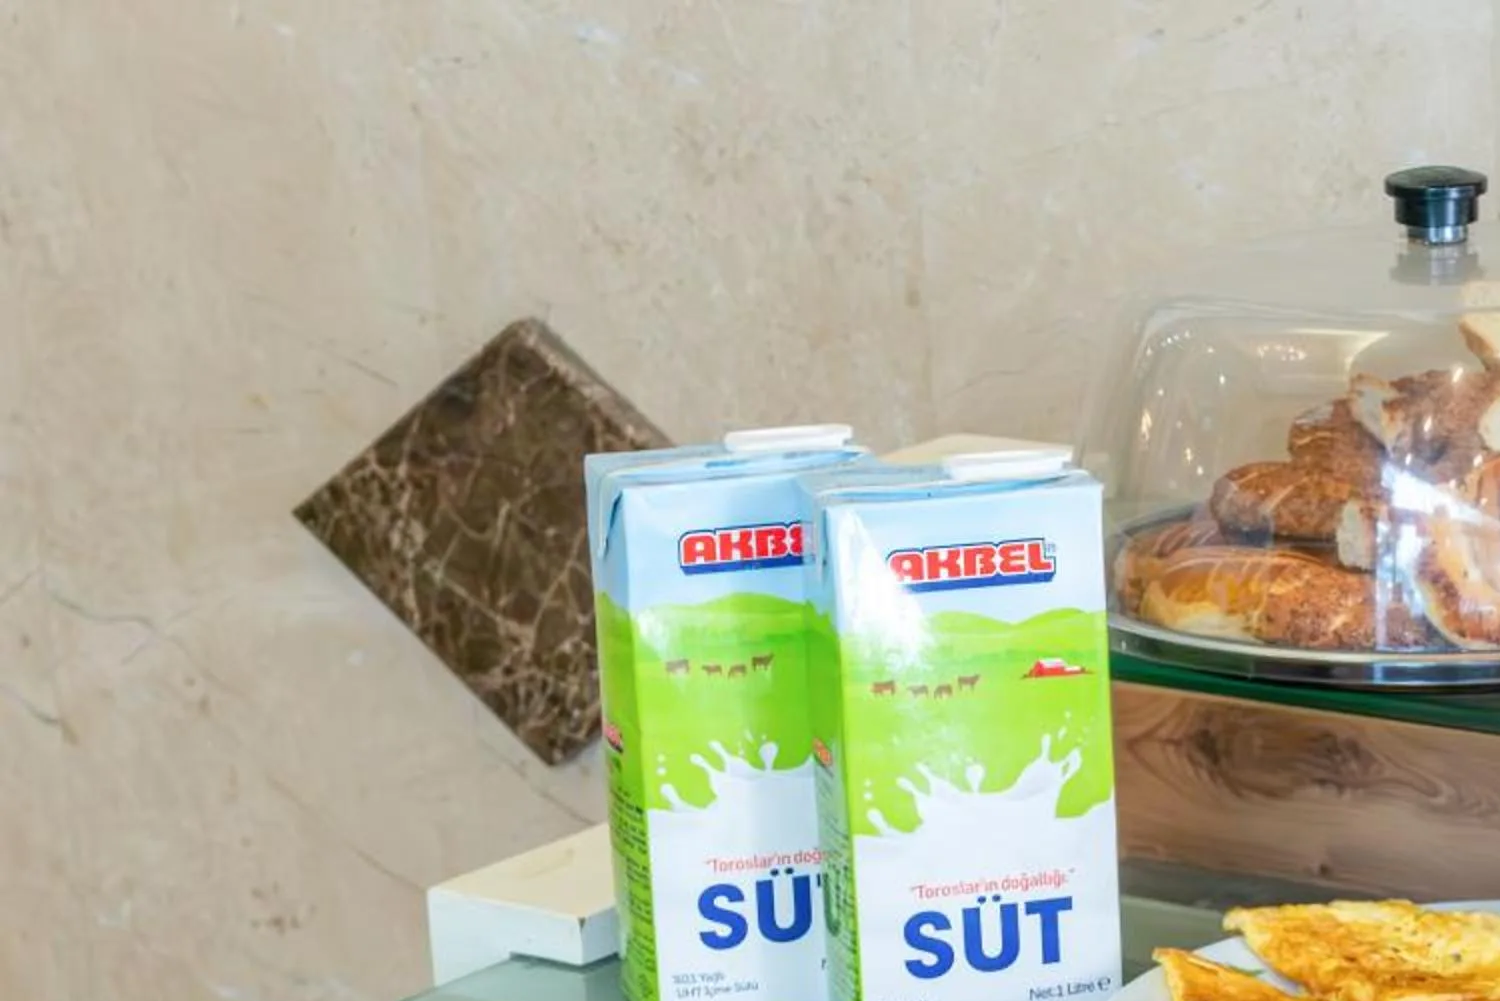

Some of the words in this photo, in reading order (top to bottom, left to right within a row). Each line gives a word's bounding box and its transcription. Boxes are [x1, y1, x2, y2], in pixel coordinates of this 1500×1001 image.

[888, 541, 1055, 586] AKBEL
[698, 867, 821, 950] SÜ
[903, 894, 1073, 979] SÜT
